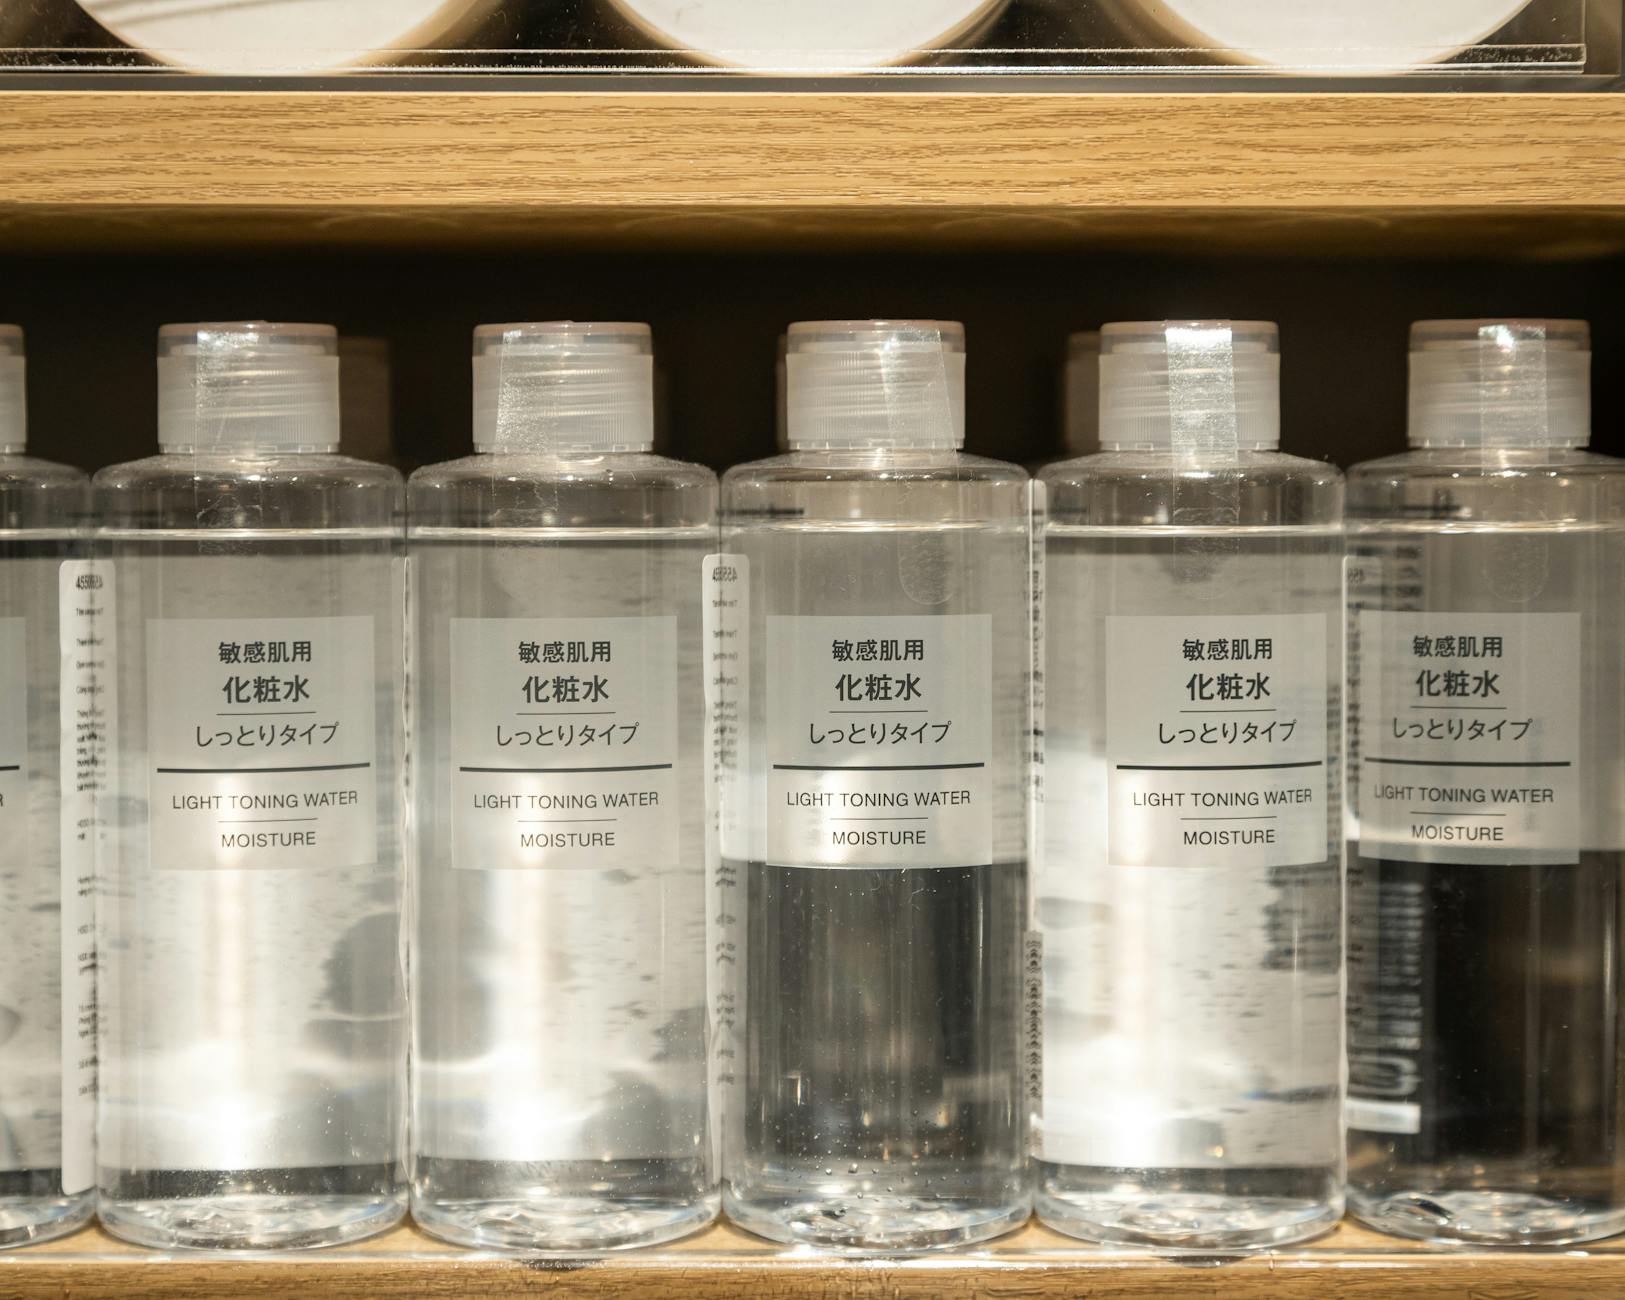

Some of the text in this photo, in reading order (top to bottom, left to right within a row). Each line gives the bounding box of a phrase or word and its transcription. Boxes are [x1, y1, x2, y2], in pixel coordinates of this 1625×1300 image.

[219, 641, 311, 663] 敏感肌用
[518, 641, 611, 663] 敏感肌用
[832, 639, 924, 662] 敏感肌用
[1182, 638, 1272, 661] 敏感肌用
[1413, 635, 1503, 658] 敏感肌用
[223, 675, 310, 703] 化粧水
[522, 675, 609, 703] 化粧水
[835, 673, 922, 701] 化粧水
[1186, 672, 1271, 701] 化粧水
[1416, 670, 1500, 698] 化粧水
[196, 721, 340, 747] しっとりタイプ
[496, 721, 639, 747] しっとりタイプ
[809, 720, 952, 745] しっとりタイプ
[1159, 718, 1297, 744] しっとりタイプ
[1393, 717, 1533, 741] しっとりタイプ
[172, 790, 358, 810] LIGHT TONING WATER
[474, 792, 659, 809] LIGHT TONING WATER
[787, 790, 971, 807] LIGHT TONING WATER
[1133, 788, 1312, 807] LIGHT TONING WATER
[1374, 784, 1554, 804] LIGHT TONING WATER
[221, 831, 316, 848] MOISTURE
[521, 832, 615, 848] MOISTURE
[832, 830, 926, 846] MOISTURE
[1184, 829, 1276, 845] MOISTURE
[1411, 824, 1504, 841] MOISTURE
